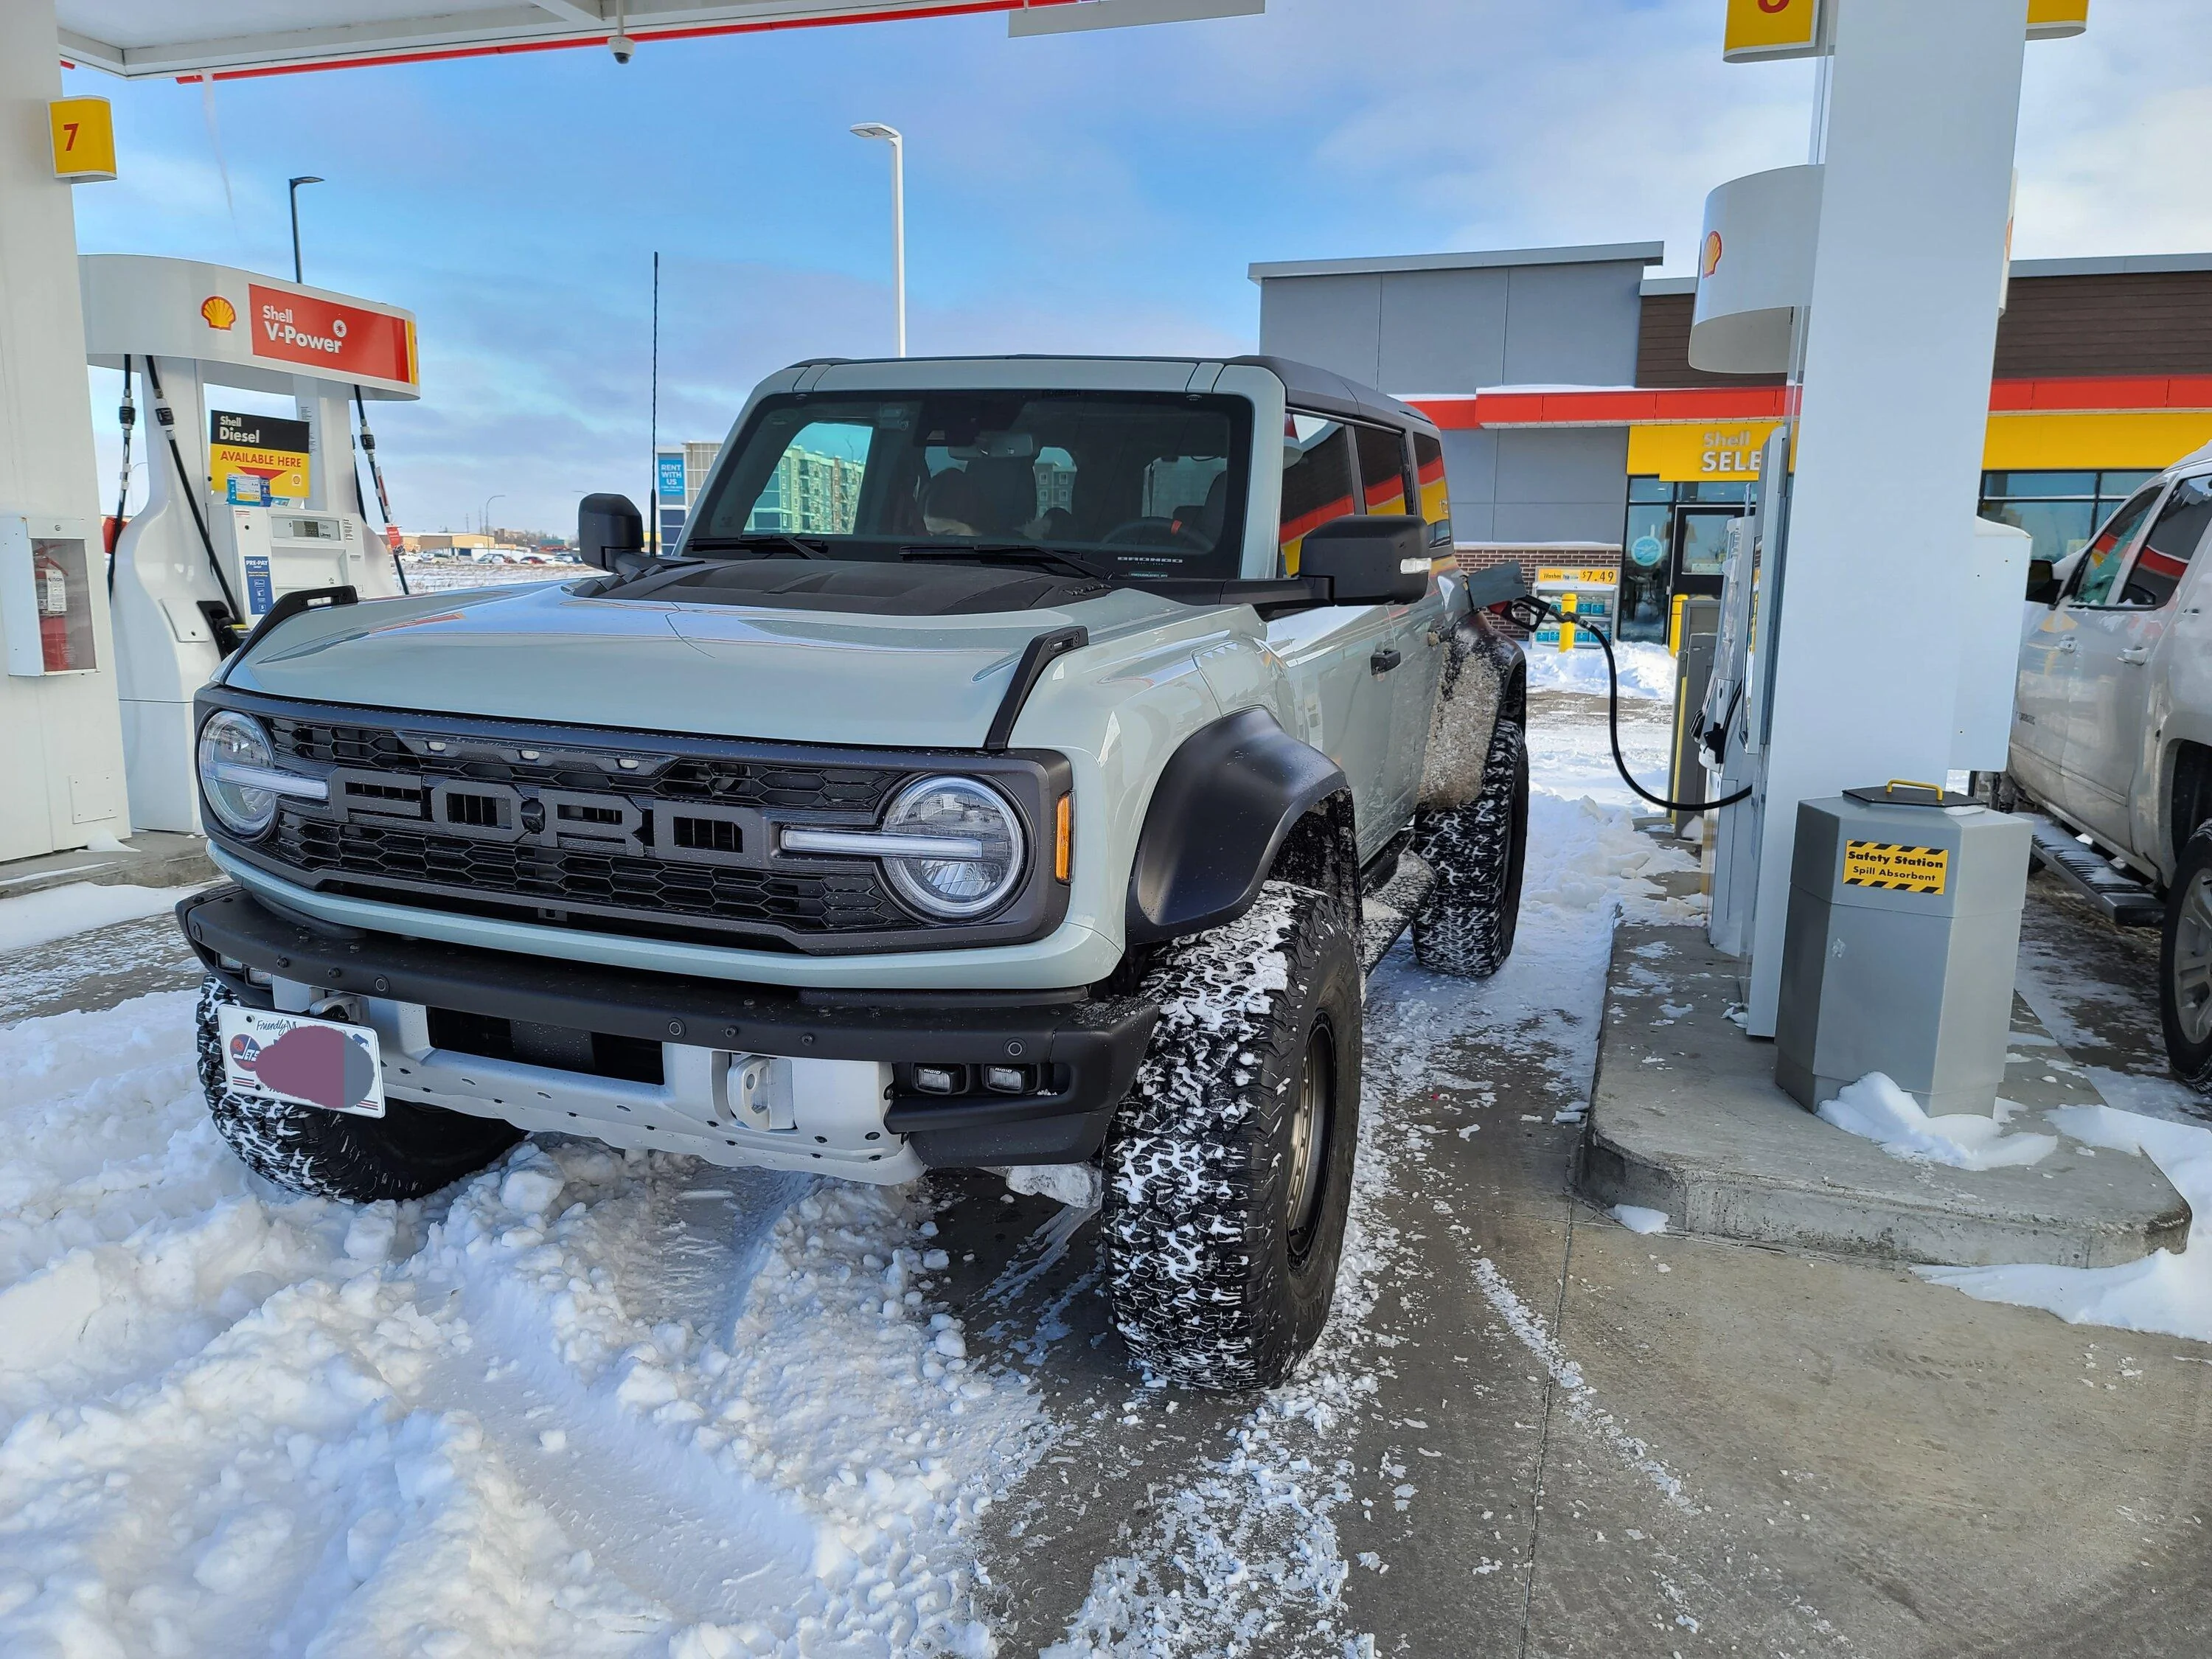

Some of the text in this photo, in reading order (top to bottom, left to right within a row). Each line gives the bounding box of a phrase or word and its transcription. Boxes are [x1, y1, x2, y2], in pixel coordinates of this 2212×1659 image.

[63, 123, 79, 151] 7
[262, 305, 293, 324] Shell
[264, 321, 342, 353] V-Power
[220, 416, 242, 427] Shell
[220, 426, 260, 443] Diesel
[1703, 430, 1750, 448] Shell
[220, 451, 302, 467] AVAILABLE HERE
[1582, 571, 1614, 582] $7.49
[331, 766, 770, 869] FORD
[1848, 851, 1944, 869] Safety Station
[1853, 866, 1935, 881] Spill Absorbent
[256, 1018, 287, 1037] Friendly
[233, 1037, 260, 1062] JETS
